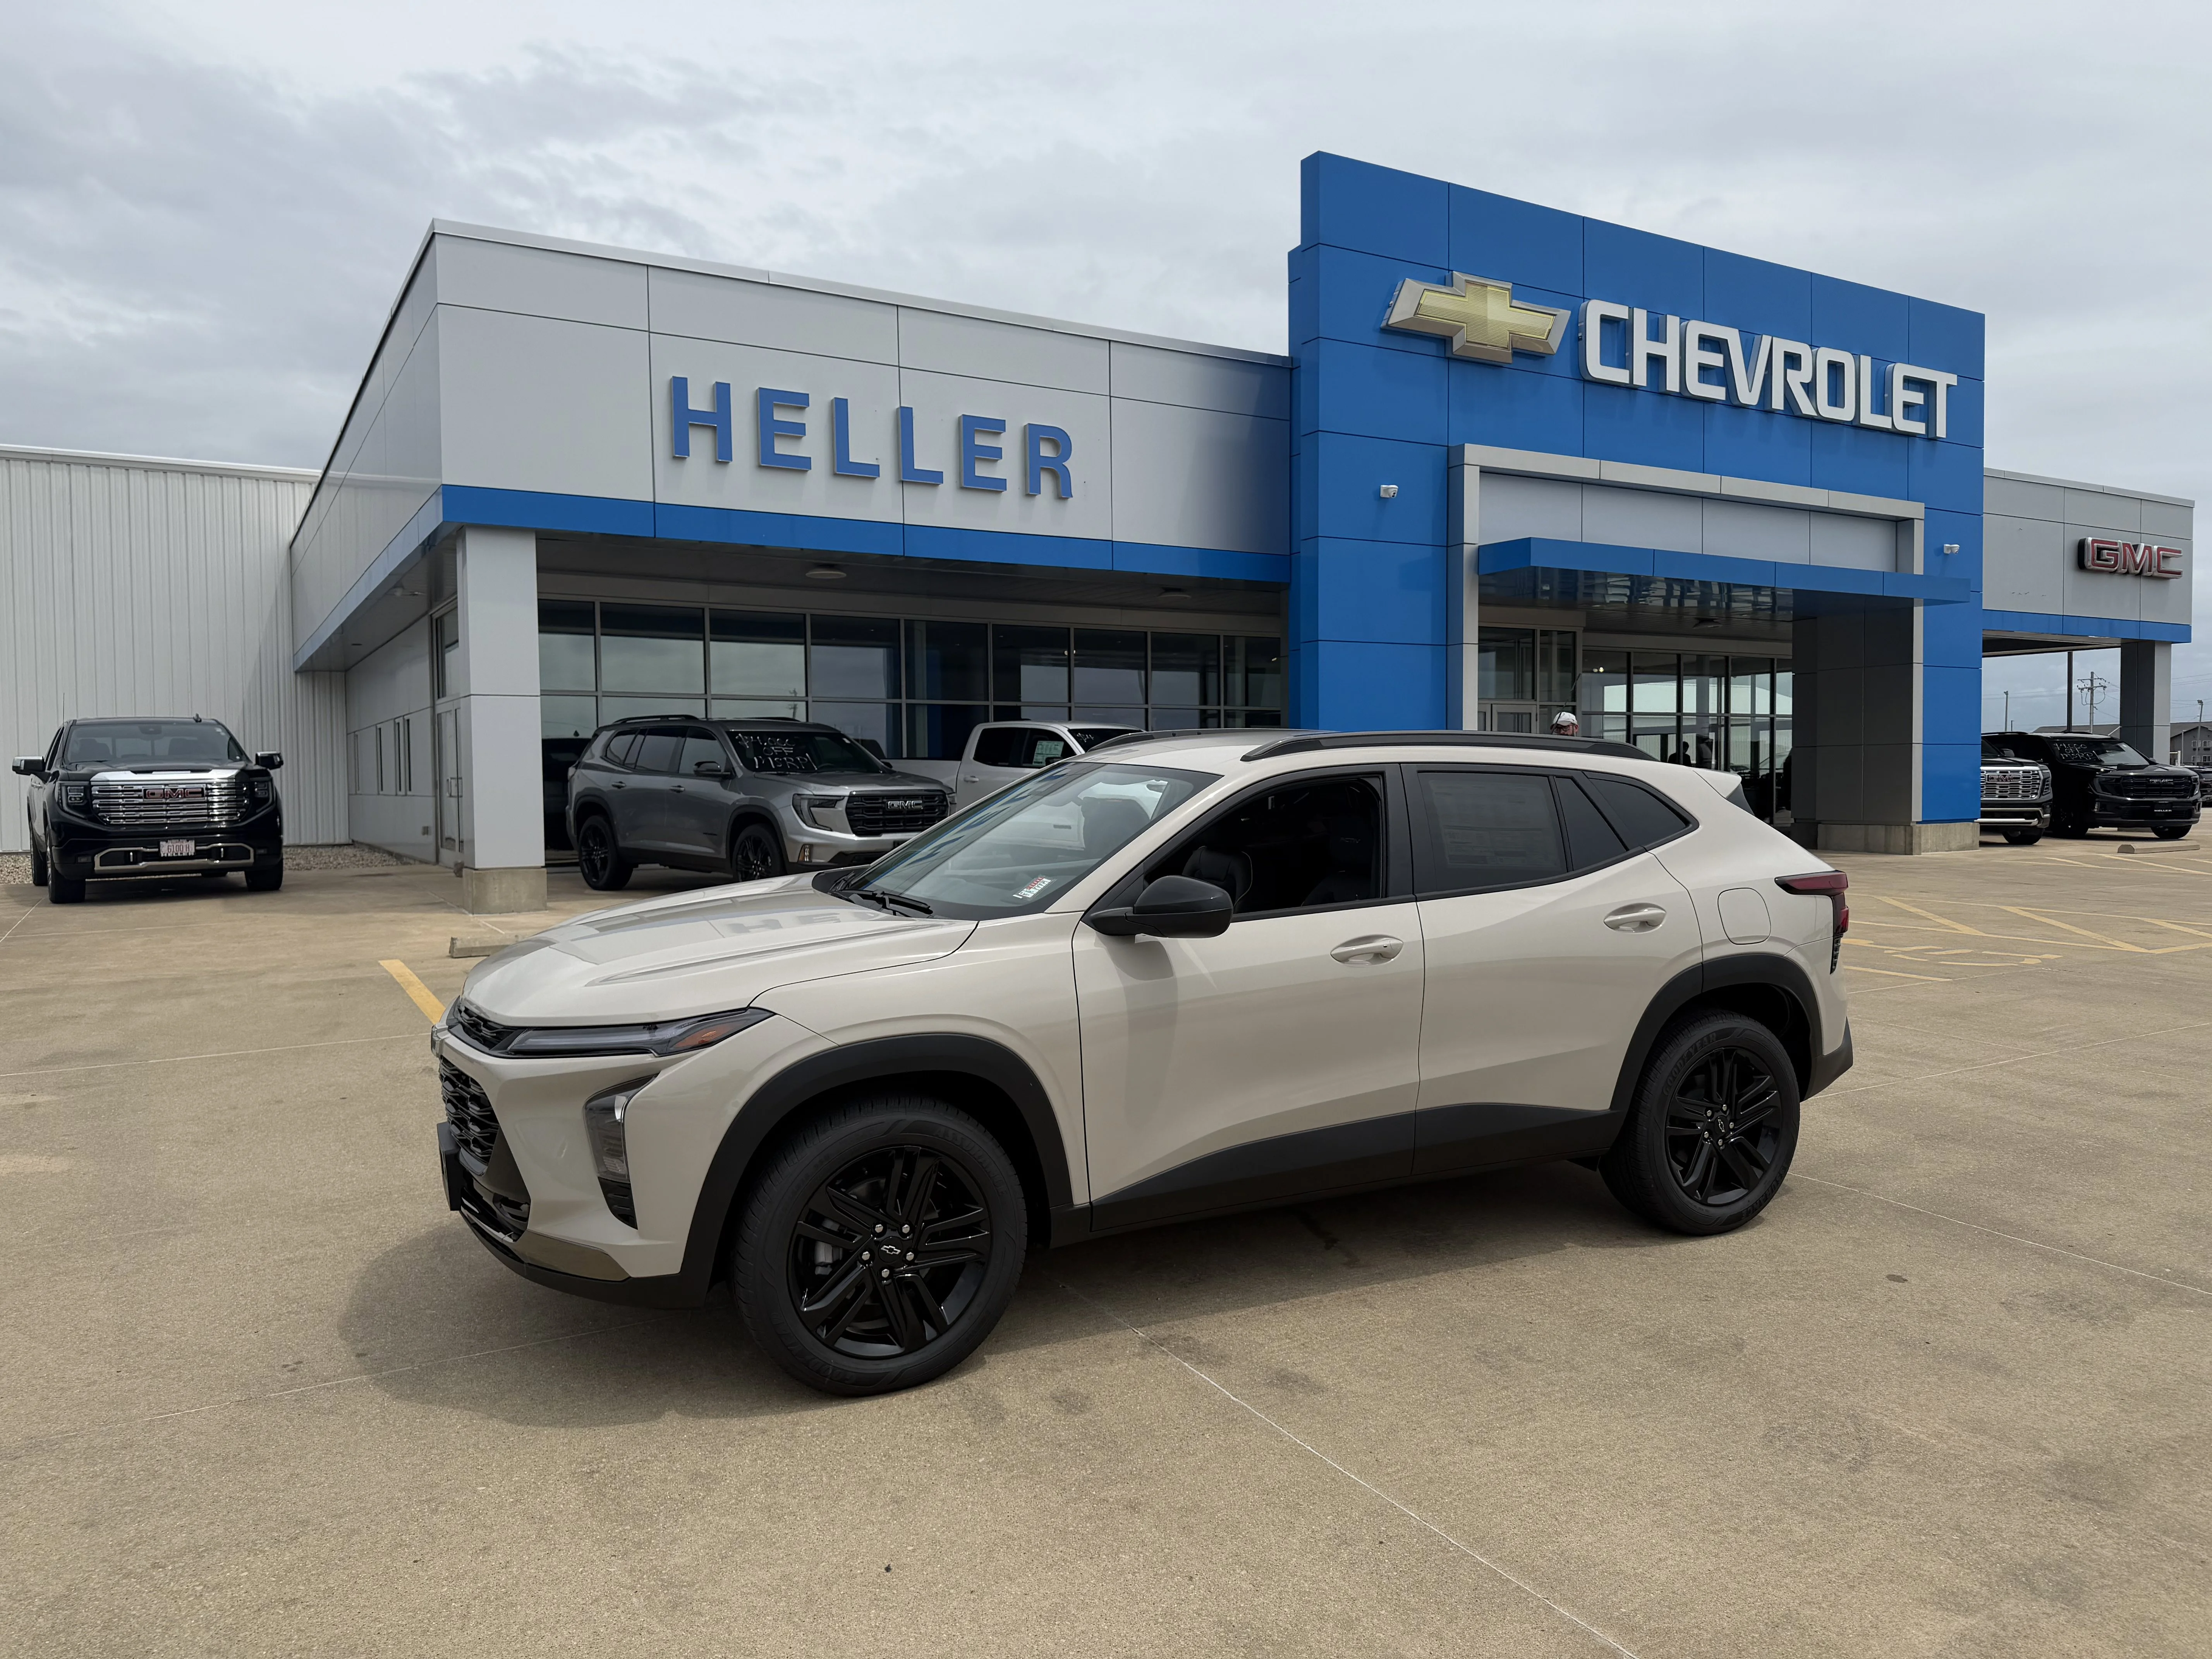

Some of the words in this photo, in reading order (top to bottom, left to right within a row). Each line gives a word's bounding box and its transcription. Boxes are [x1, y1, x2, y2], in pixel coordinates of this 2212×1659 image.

[1578, 299, 1958, 439] CHEVROLET
[670, 376, 1073, 499] HELLER
[2078, 537, 2183, 579] GMC
[763, 747, 793, 755] OFF
[146, 788, 202, 799] GMC
[888, 800, 923, 809] GMC
[1663, 1032, 1716, 1096] GOODYEAR
